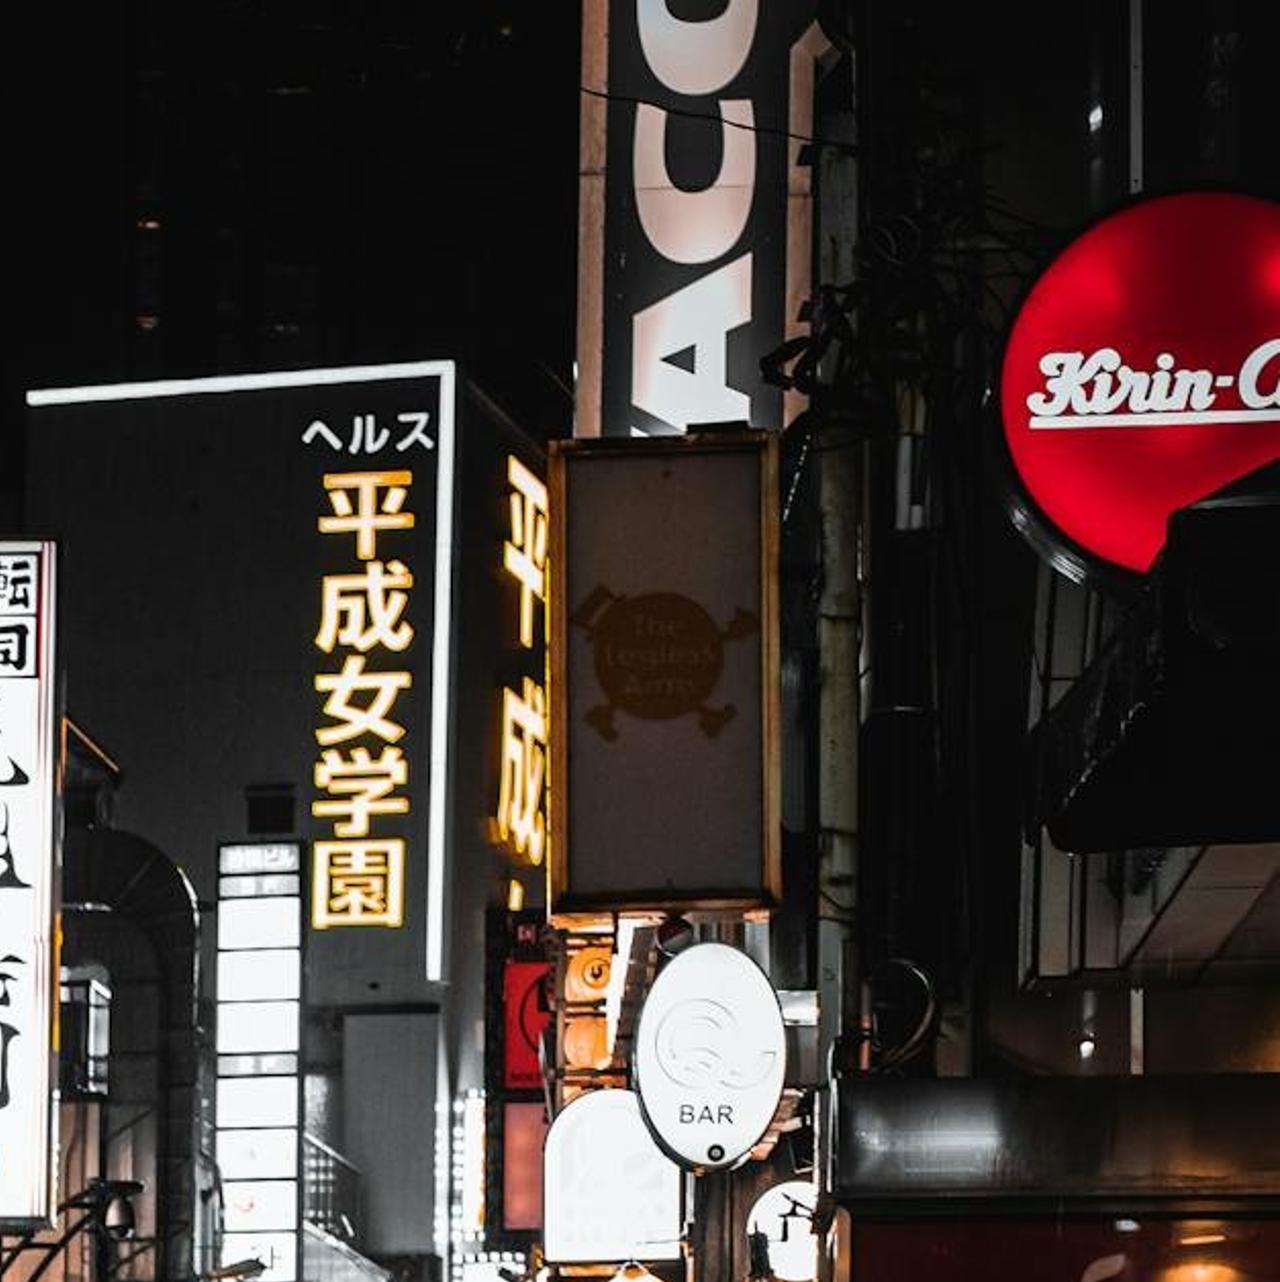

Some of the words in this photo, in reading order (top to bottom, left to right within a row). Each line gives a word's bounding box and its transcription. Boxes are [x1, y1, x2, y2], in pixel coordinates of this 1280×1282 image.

[301, 411, 435, 455] ヘルス
[311, 470, 415, 930] 平成女学園
[678, 1104, 734, 1125] BAR
